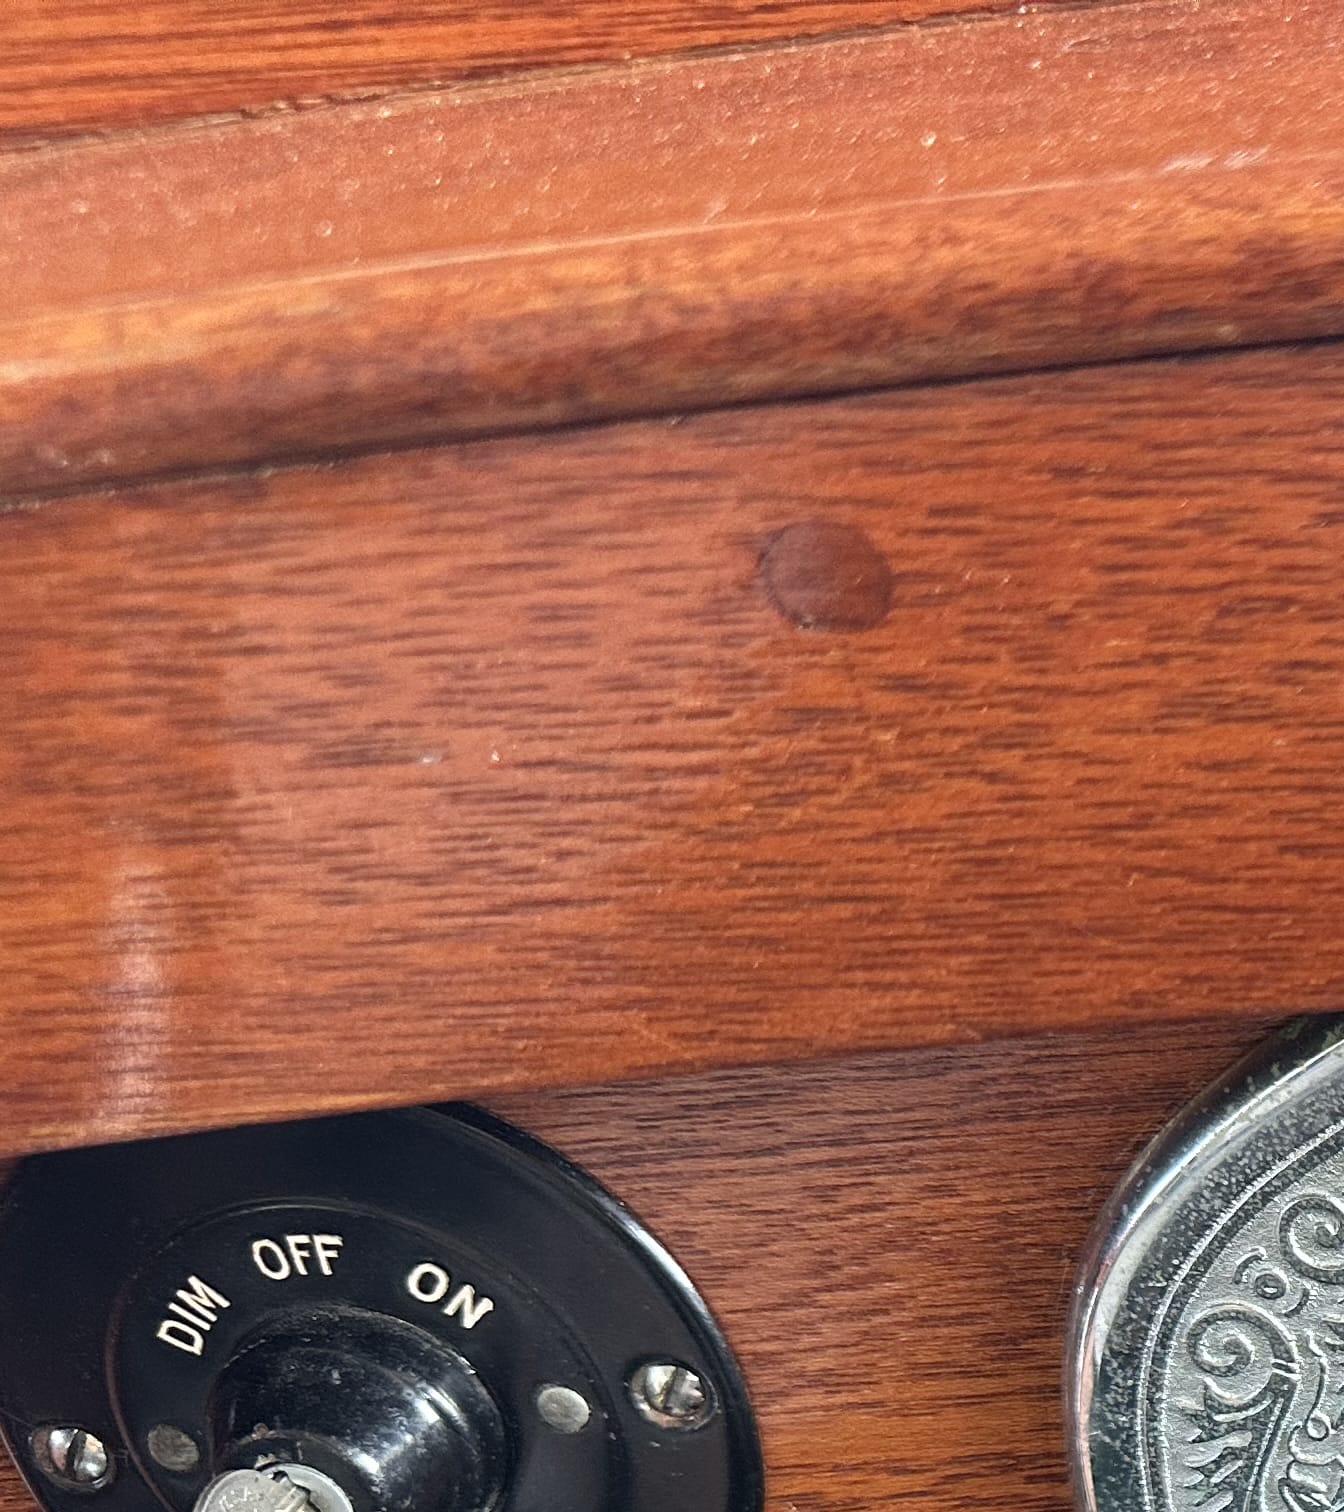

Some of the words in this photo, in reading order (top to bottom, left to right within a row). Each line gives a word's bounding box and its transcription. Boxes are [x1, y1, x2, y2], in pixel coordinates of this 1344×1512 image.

[157, 1275, 231, 1355] DIM
[251, 1234, 344, 1281] OFF
[406, 1263, 494, 1329] ON
